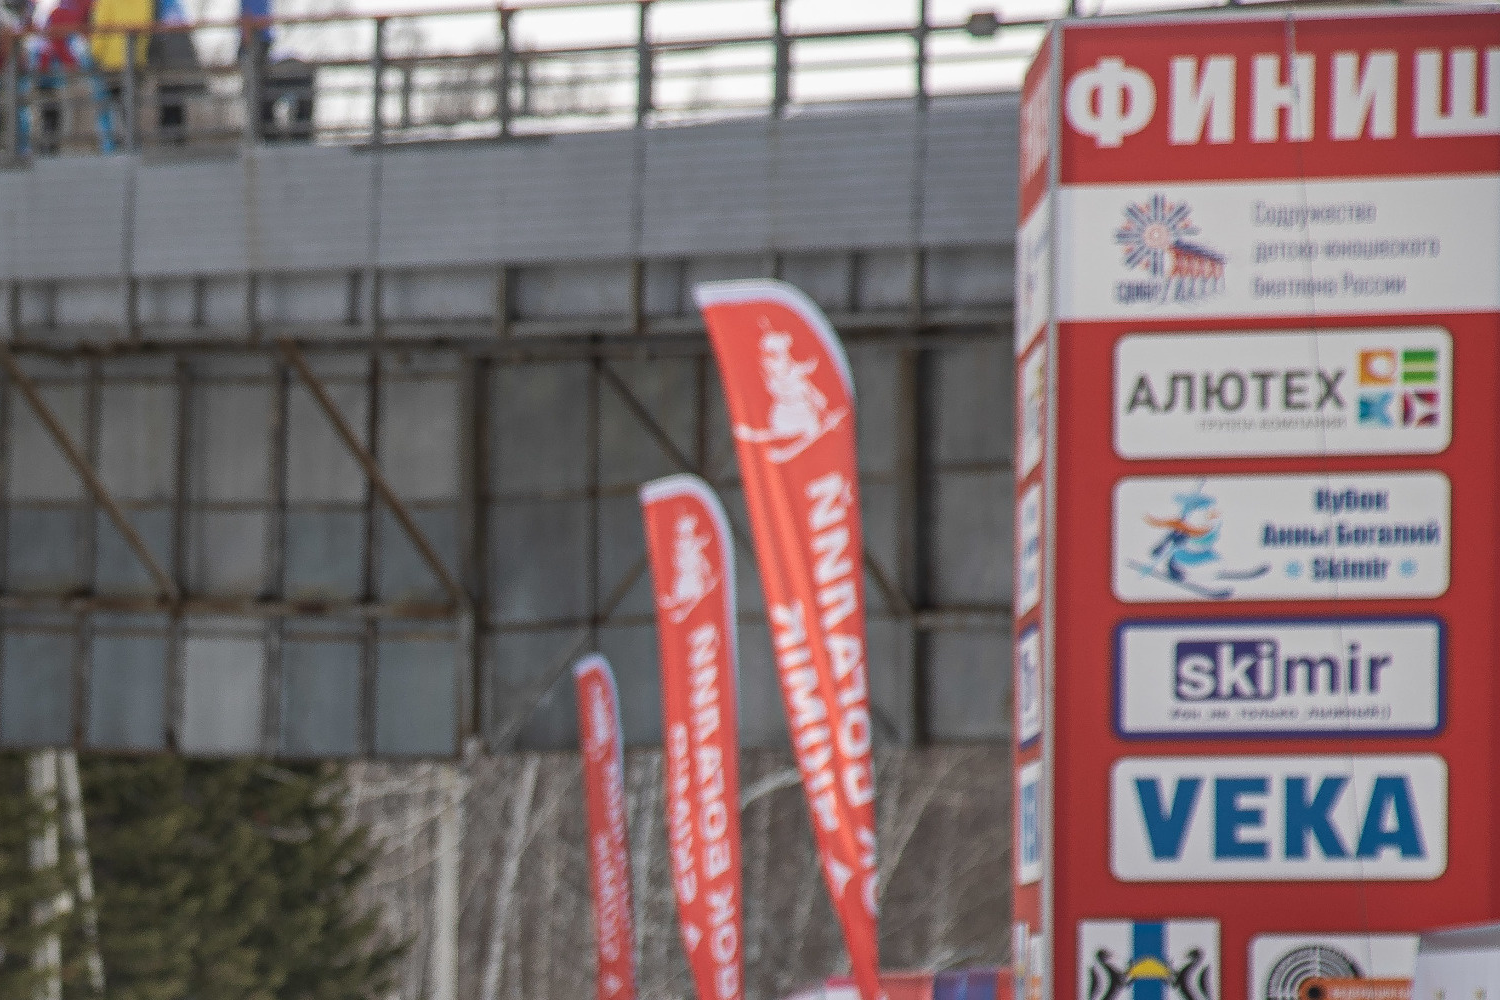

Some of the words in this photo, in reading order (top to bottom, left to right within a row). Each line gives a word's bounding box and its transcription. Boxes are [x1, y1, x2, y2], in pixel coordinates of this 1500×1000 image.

[1064, 46, 1500, 149] ФИНИШ
[1127, 369, 1348, 414] АЛЮТЕХ
[1314, 487, 1390, 513] Кубок
[1263, 524, 1330, 546] Анны
[1336, 520, 1441, 547] Богалий
[1312, 556, 1391, 580] Skimir
[1177, 641, 1392, 698] skimir
[1133, 774, 1428, 860] VEKA
